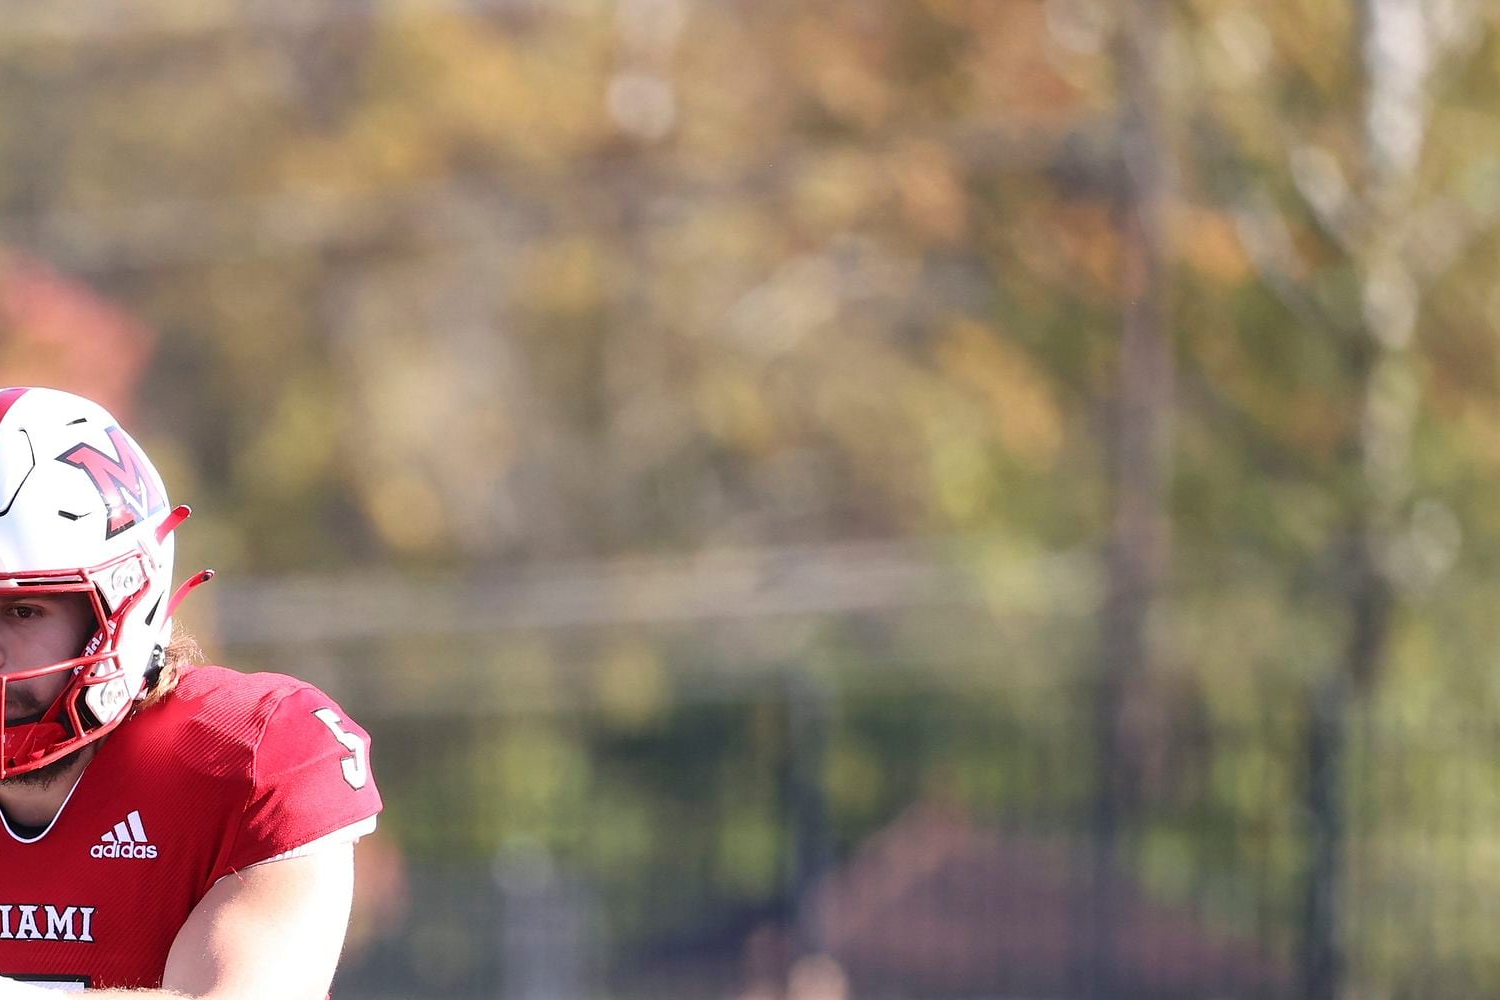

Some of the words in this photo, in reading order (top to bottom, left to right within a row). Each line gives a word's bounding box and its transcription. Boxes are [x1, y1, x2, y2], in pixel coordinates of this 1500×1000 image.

[54, 425, 165, 540] M
[310, 706, 368, 791] 5
[90, 839, 157, 860] adidas
